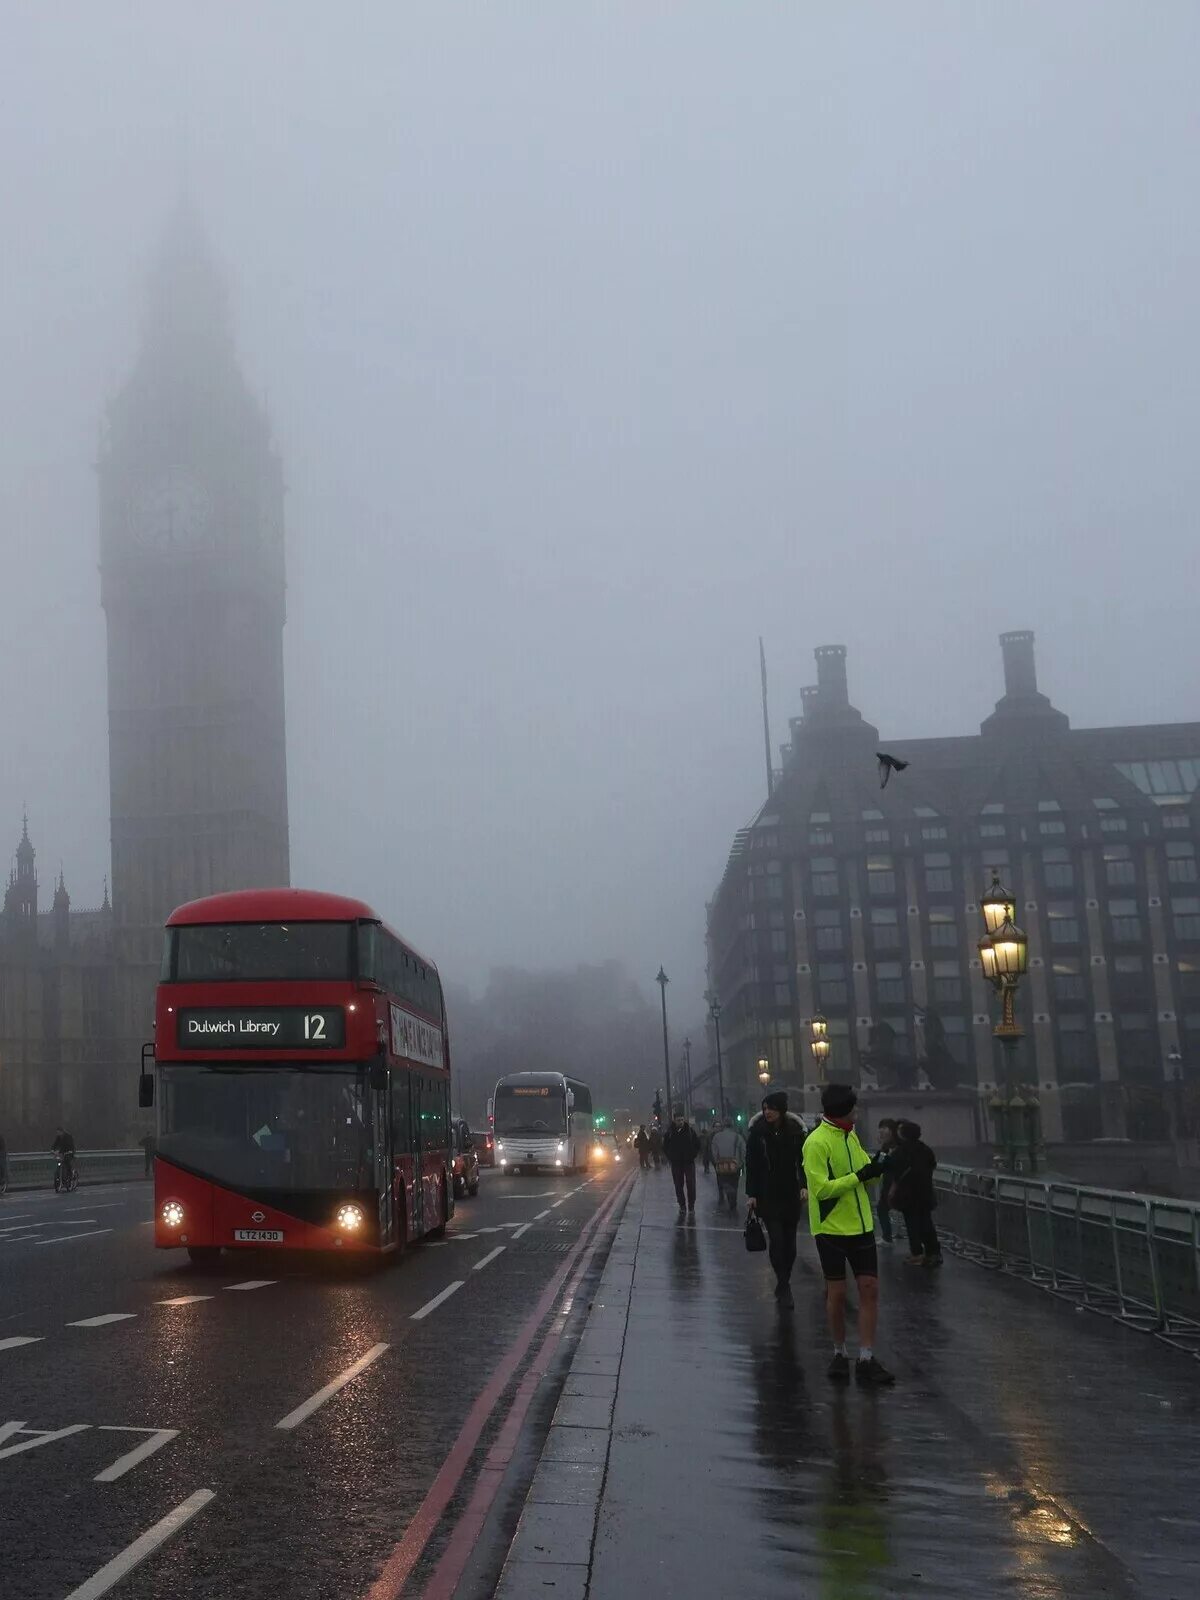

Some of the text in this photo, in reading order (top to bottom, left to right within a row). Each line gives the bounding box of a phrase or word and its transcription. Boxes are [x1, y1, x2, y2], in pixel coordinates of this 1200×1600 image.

[188, 1014, 326, 1040] Dulwich Library 12
